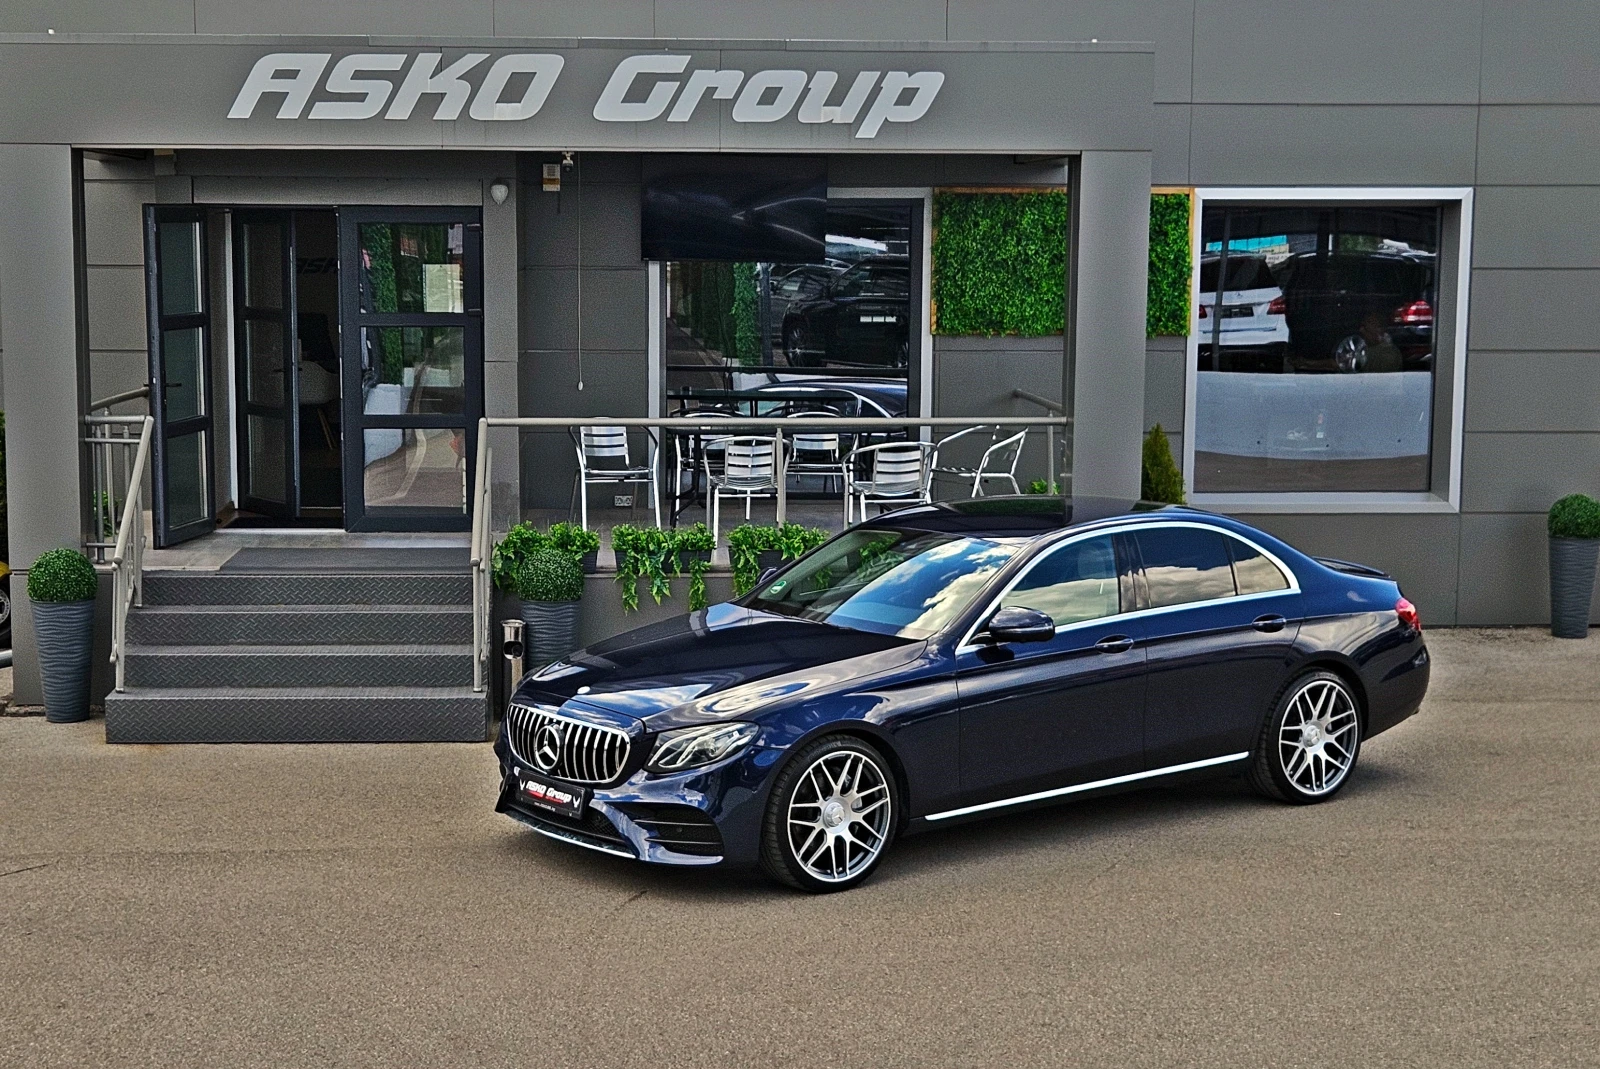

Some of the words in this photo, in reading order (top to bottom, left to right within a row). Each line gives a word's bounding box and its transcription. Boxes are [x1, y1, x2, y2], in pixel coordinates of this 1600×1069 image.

[227, 52, 565, 121] ASKO
[593, 54, 946, 139] Group
[525, 780, 547, 795] ASKO
[546, 787, 572, 803] Group
